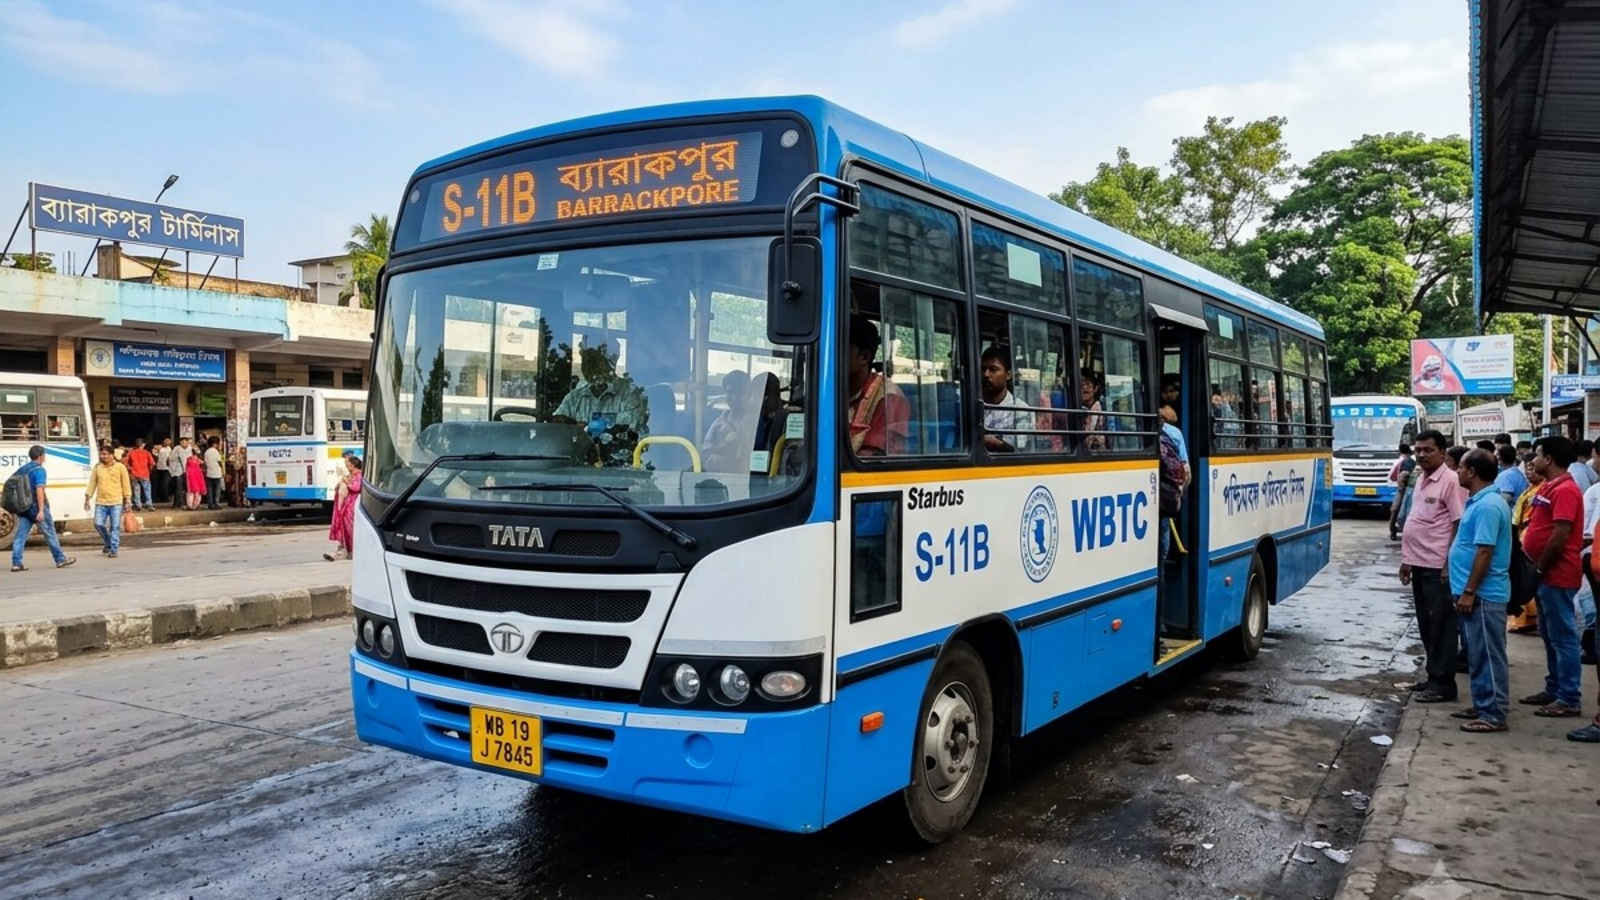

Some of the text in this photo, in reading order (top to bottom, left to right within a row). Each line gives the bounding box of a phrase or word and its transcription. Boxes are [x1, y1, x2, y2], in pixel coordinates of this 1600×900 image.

[557, 140, 739, 192] ব্যারাকপুর
[39, 196, 152, 239] ব্যারাকপুর
[442, 170, 536, 233] S-11B
[556, 178, 740, 220] BARRACKPORE
[907, 485, 965, 510] Starbus
[488, 524, 545, 549] TATA
[1071, 490, 1149, 553] WBTC
[915, 523, 990, 582] S-11B
[484, 713, 530, 741] WB 19
[480, 738, 533, 767] J 7845
